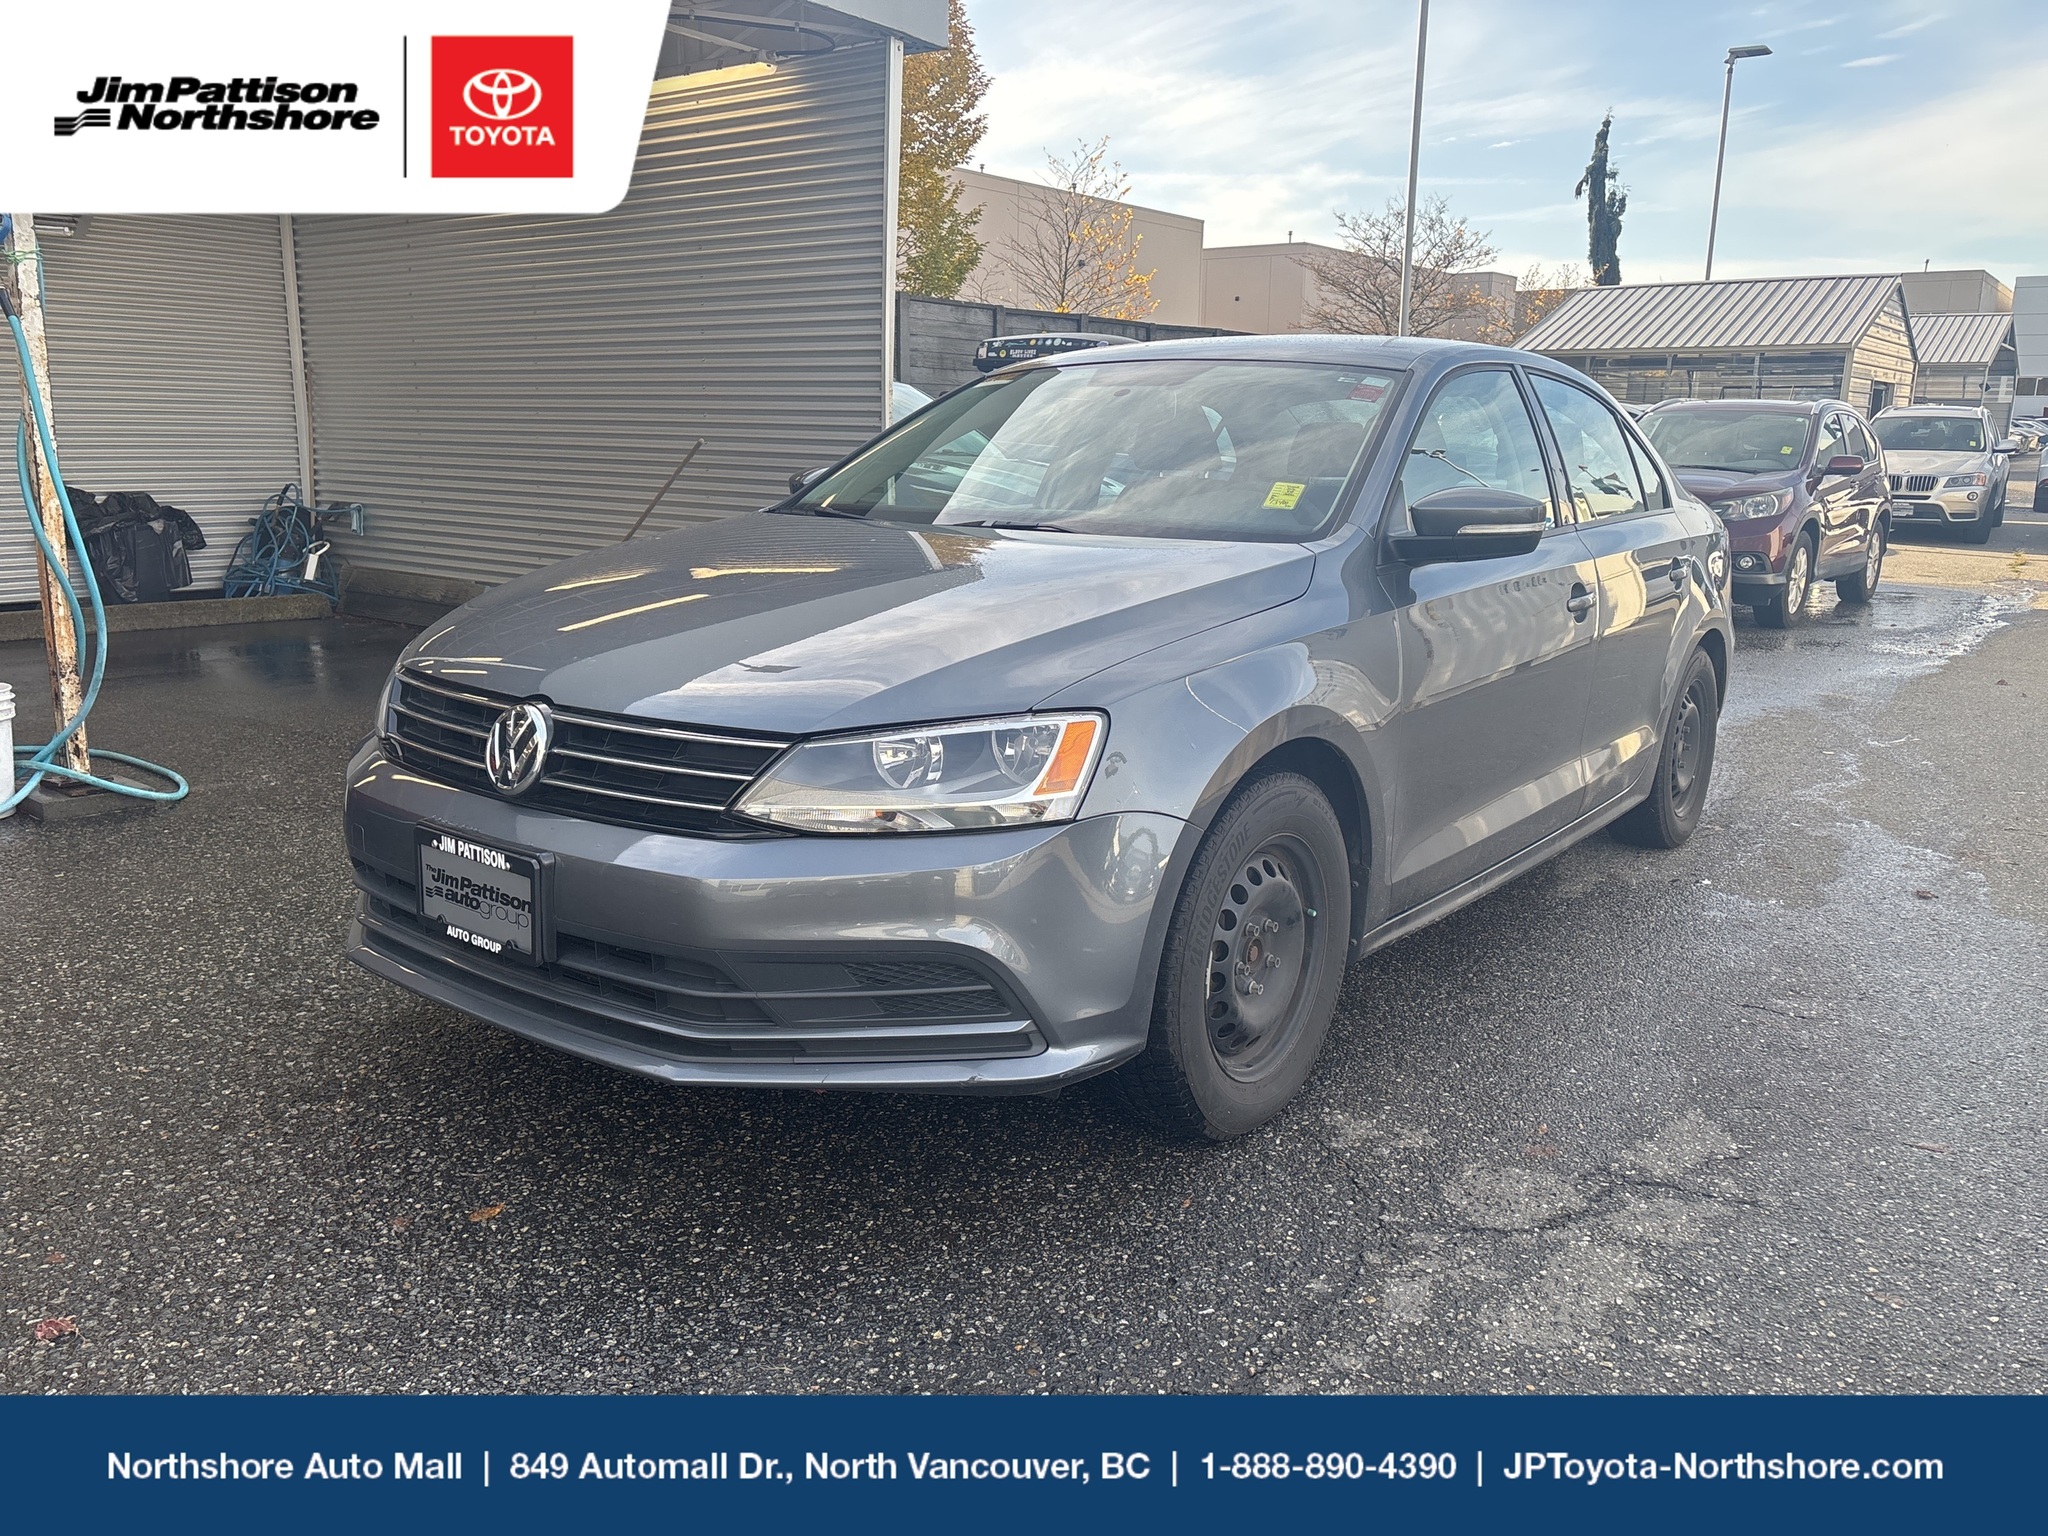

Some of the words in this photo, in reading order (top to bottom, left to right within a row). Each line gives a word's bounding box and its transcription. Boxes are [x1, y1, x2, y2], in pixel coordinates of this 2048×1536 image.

[425, 863, 437, 873] The
[439, 835, 456, 855] JIM
[457, 840, 506, 870] PATTISON
[1189, 822, 1252, 968] BRIDGESTONE
[446, 925, 470, 943] AUTO
[471, 934, 502, 954] GROUP
